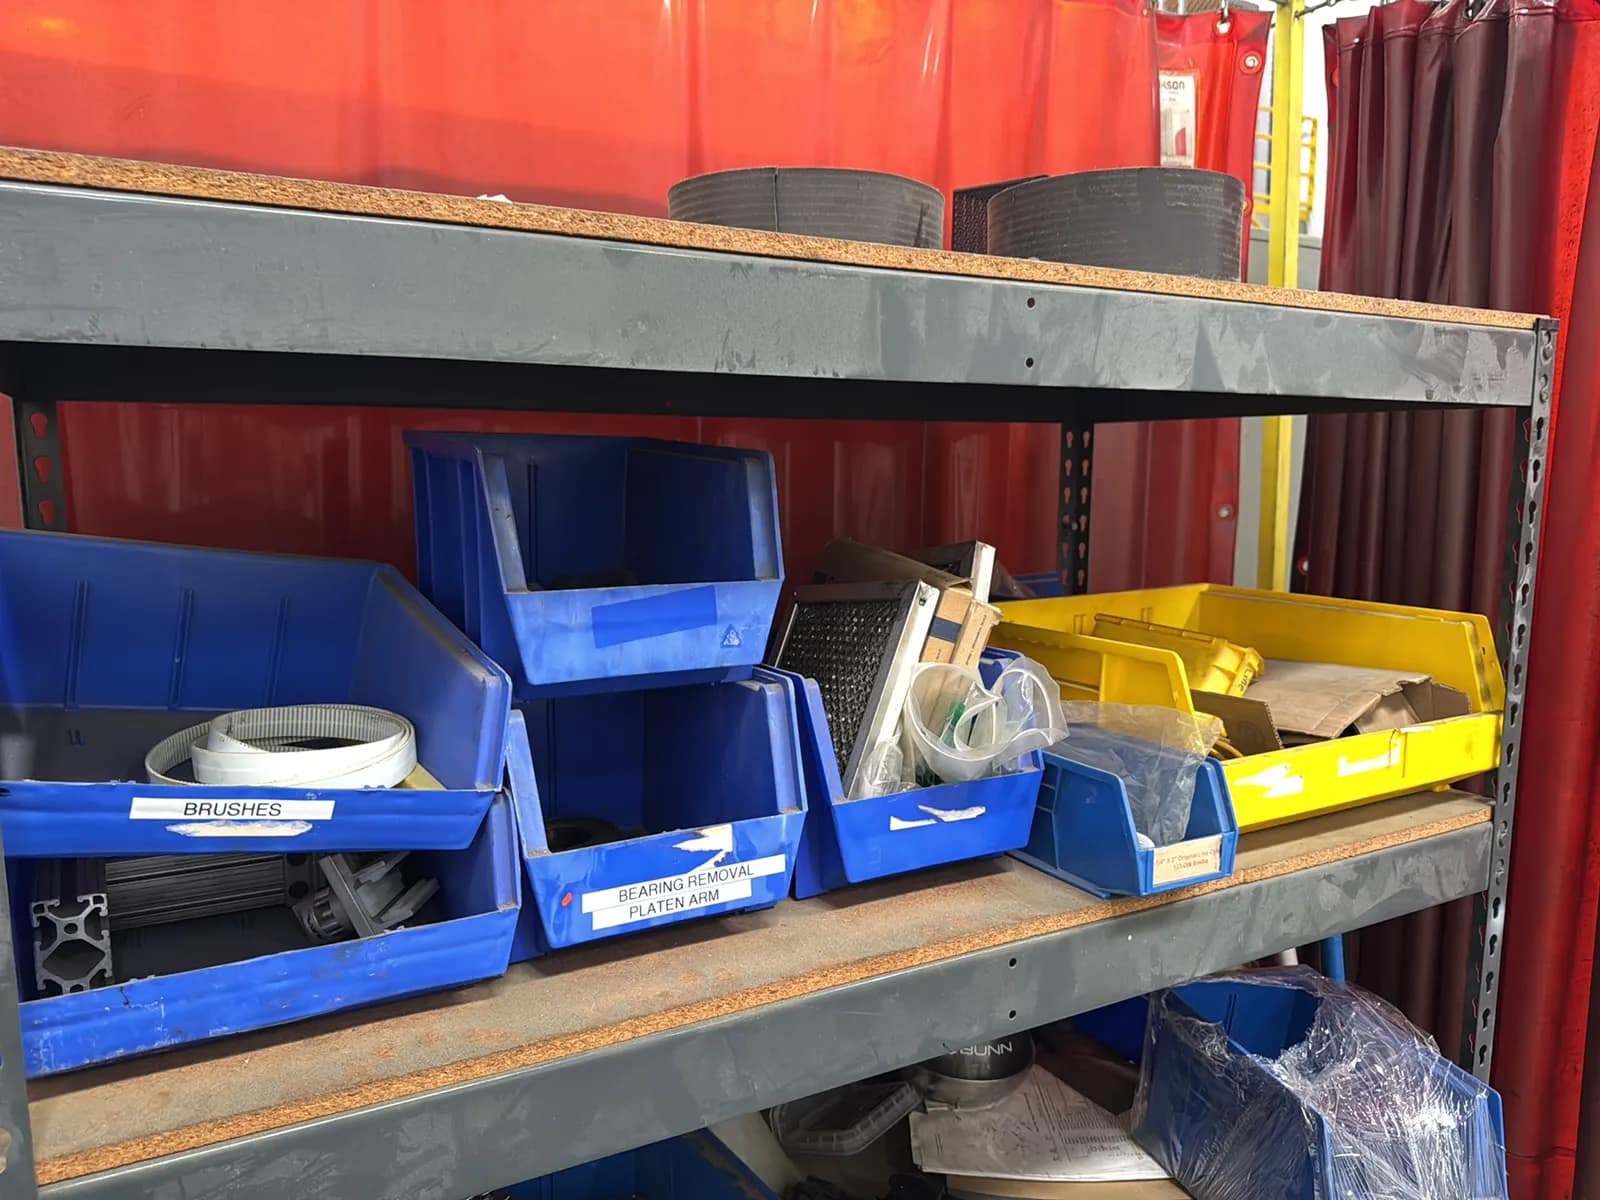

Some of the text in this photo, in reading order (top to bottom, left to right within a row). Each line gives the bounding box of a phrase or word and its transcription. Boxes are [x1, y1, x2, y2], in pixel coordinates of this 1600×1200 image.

[183, 802, 283, 817] BRUSHES
[618, 863, 754, 903] BEARING REMOVAL
[629, 888, 720, 919] PLATEN ARM
